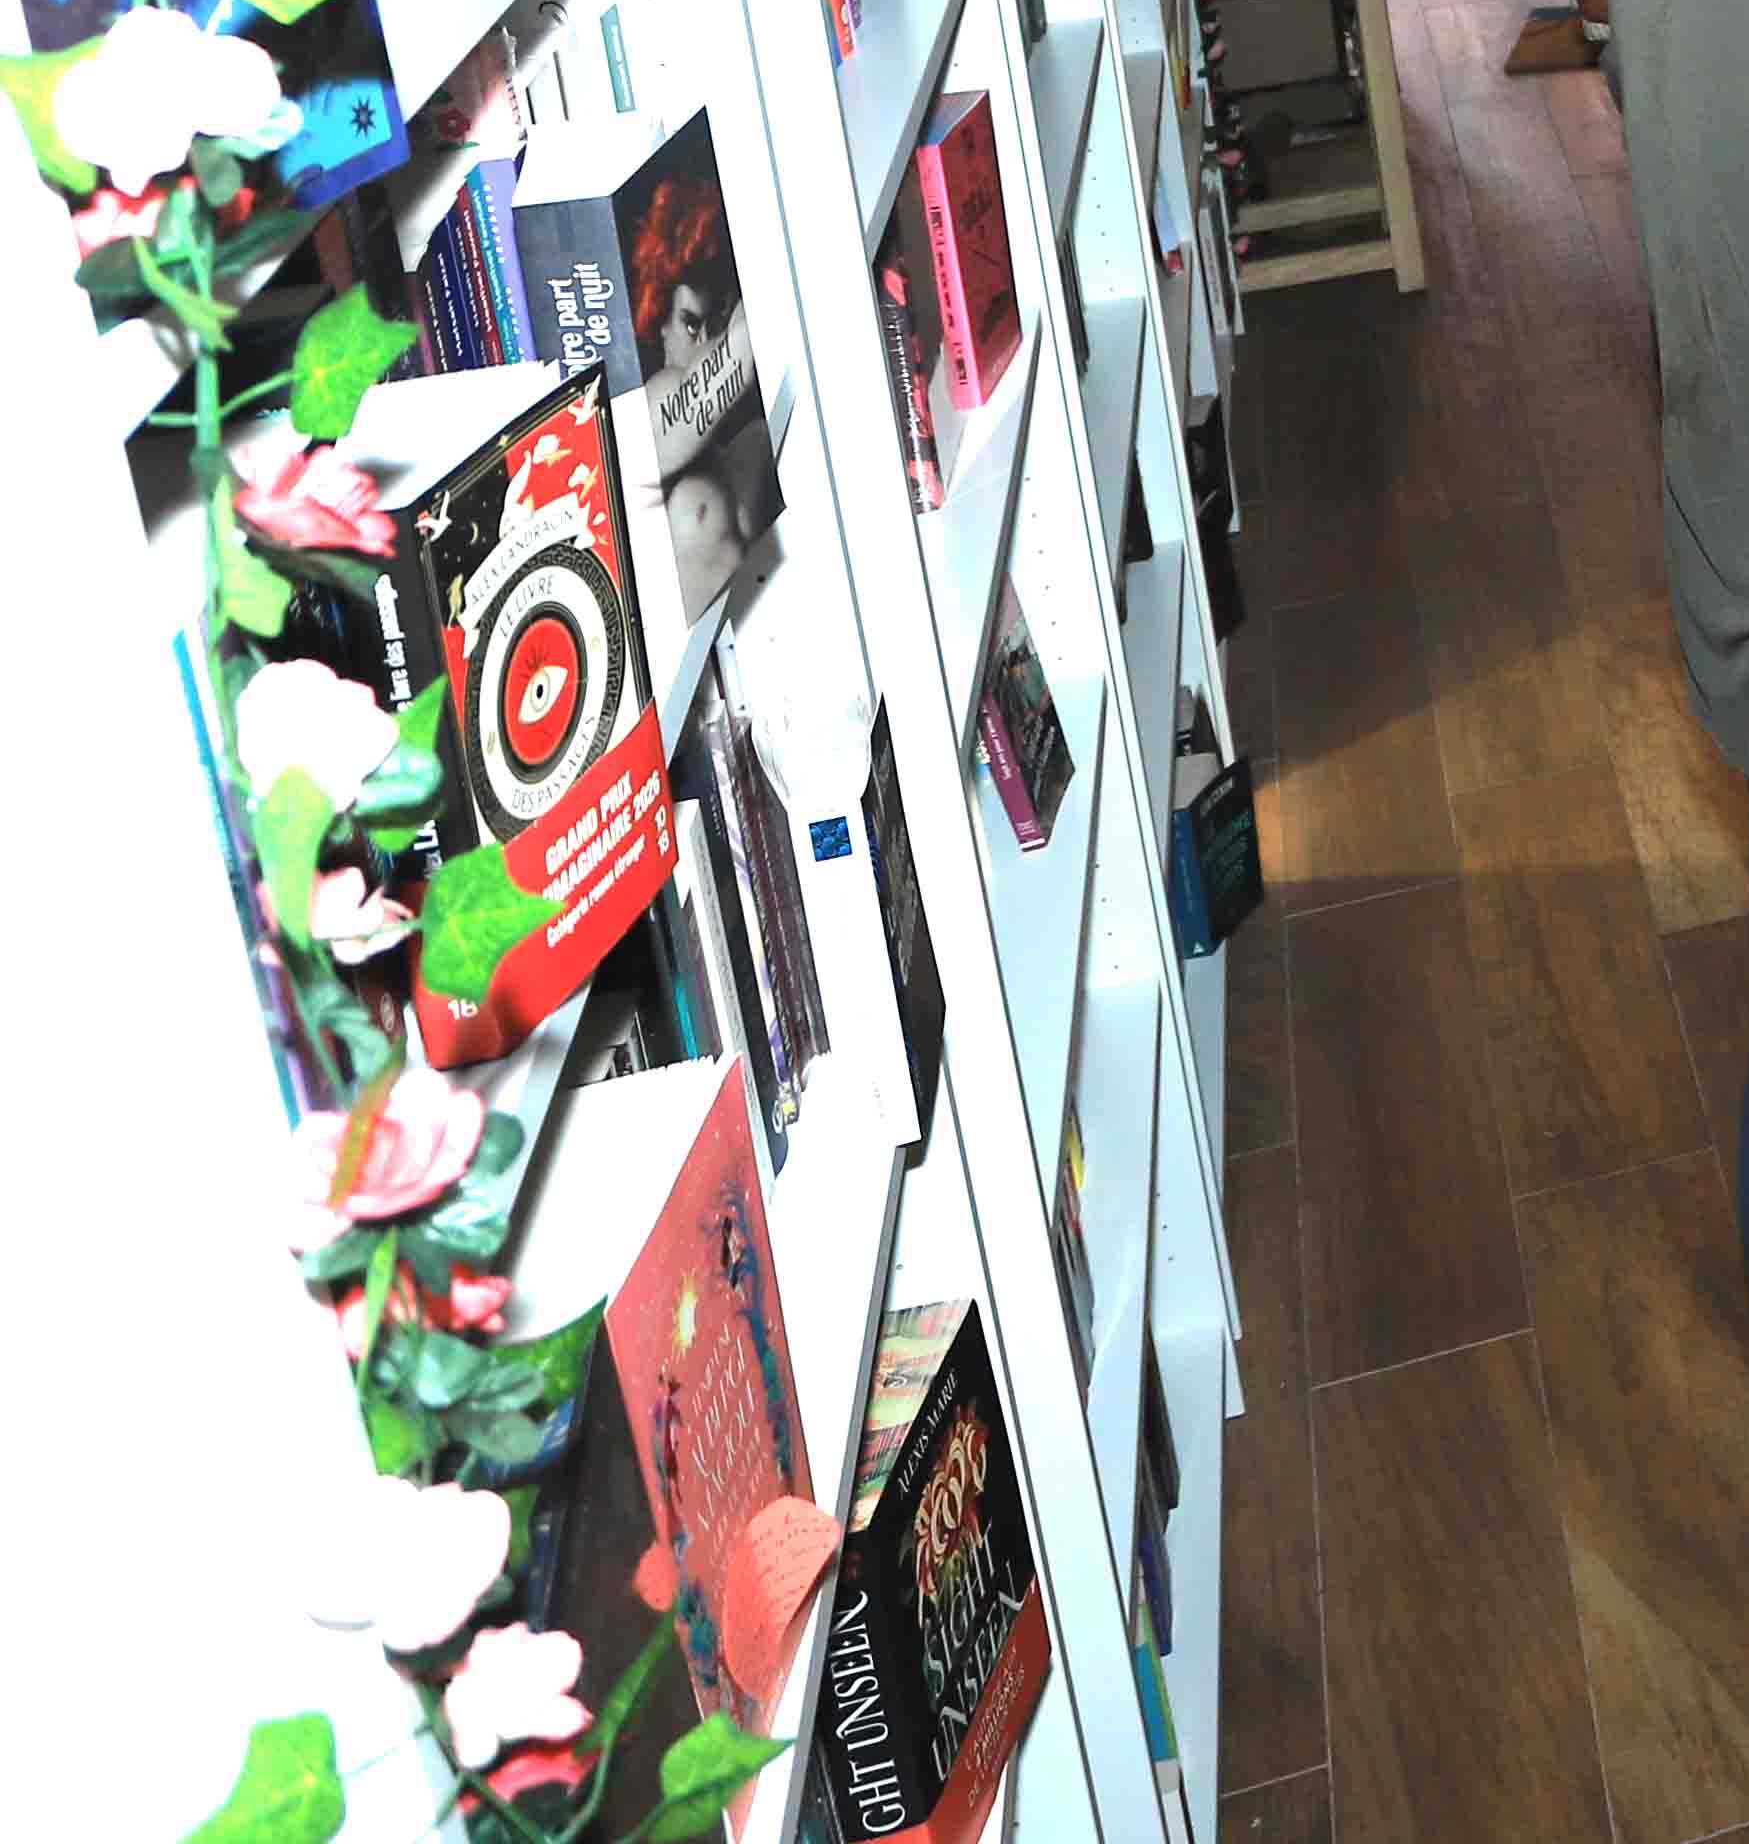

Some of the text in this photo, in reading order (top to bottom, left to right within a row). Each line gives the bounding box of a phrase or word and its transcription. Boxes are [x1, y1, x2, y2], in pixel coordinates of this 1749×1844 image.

[546, 277, 587, 328] part
[572, 261, 615, 346] de nuit
[658, 334, 735, 436] Notre part
[694, 359, 747, 437] de nuit
[515, 574, 554, 609] LIVRE
[545, 769, 633, 875] GRAND PRIX
[896, 1367, 959, 1496] ALEXIS MARIE
[831, 1591, 889, 1753] UNSEEN
[928, 1559, 1026, 1784] UNSEEN
